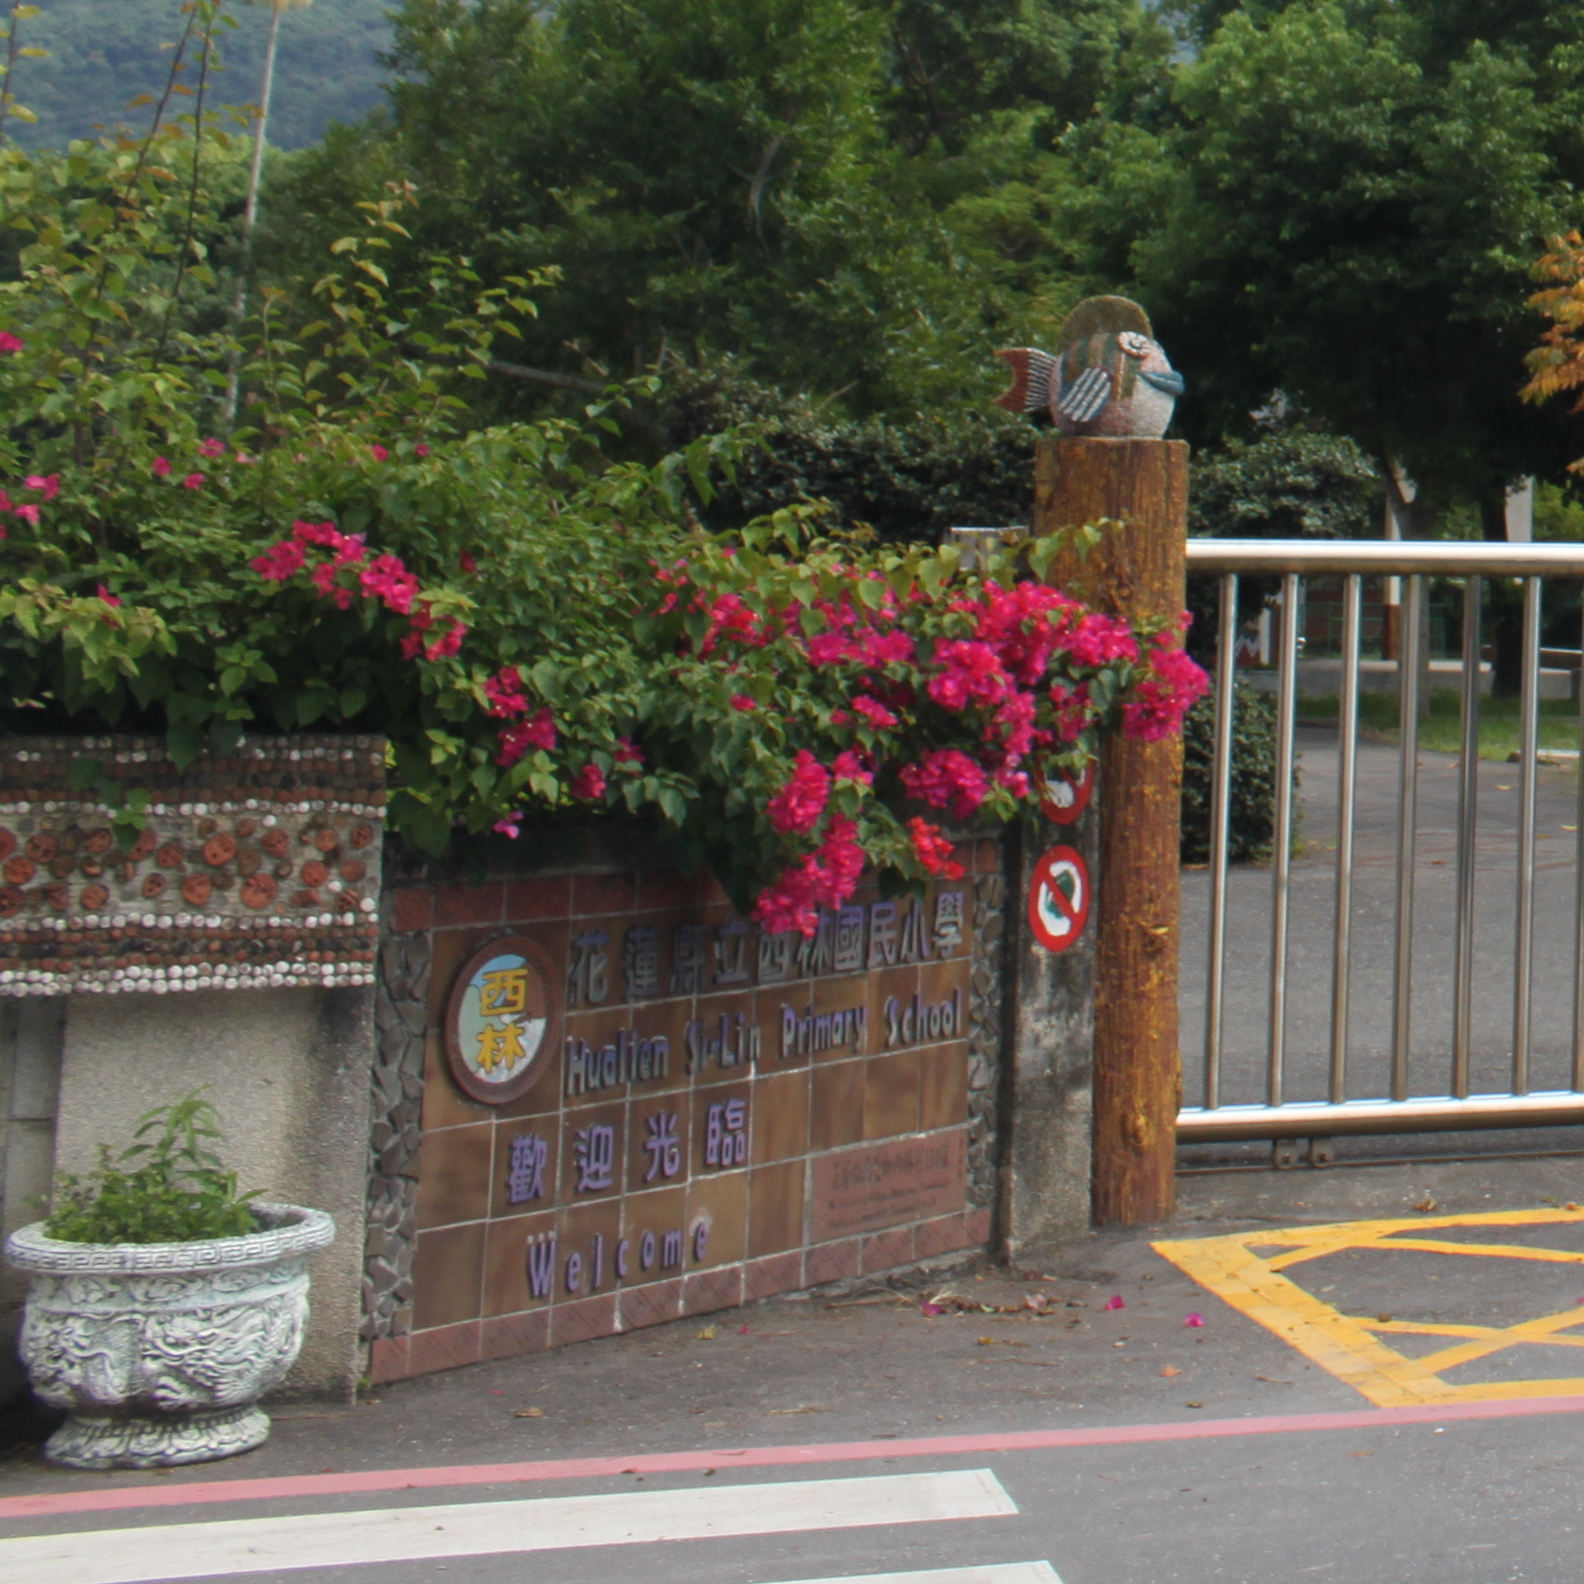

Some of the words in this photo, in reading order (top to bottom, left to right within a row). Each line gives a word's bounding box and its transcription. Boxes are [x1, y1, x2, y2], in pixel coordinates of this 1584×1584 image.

[476, 967, 529, 1072] 西林
[565, 1027, 670, 1097] Hualien
[684, 1012, 762, 1077] Si-Lin
[780, 1002, 868, 1059] Primary
[886, 986, 963, 1049] School
[507, 1098, 746, 1204] 歡迎光臨
[527, 1222, 709, 1299] Welcome
